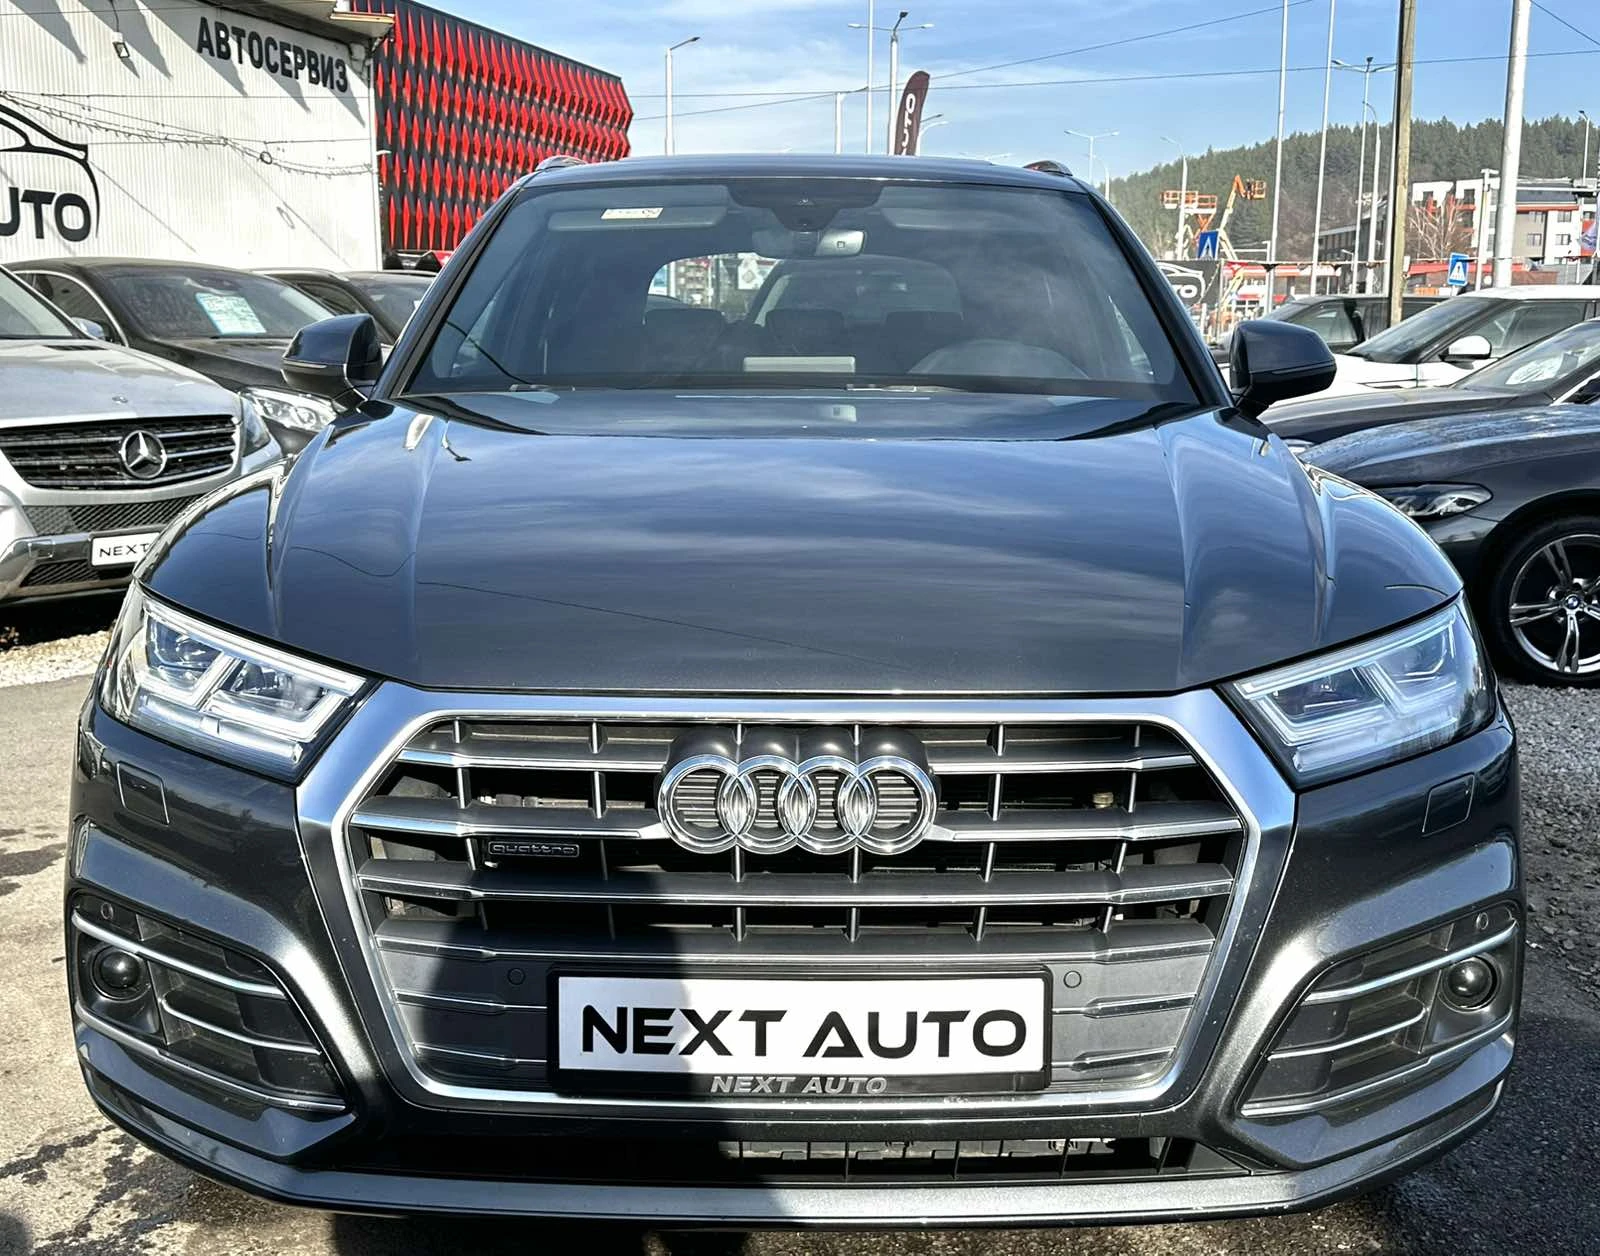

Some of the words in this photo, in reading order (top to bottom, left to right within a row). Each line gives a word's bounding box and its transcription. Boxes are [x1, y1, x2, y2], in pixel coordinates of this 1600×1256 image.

[198, 16, 349, 93] АВТОСЕРВИЗ
[99, 543, 150, 557] NEXT
[493, 844, 575, 855] quattro
[582, 1004, 788, 1057] NEXT
[802, 1009, 1027, 1060] AUTO
[710, 1076, 796, 1093] NEXT
[801, 1076, 888, 1095] AUTO
